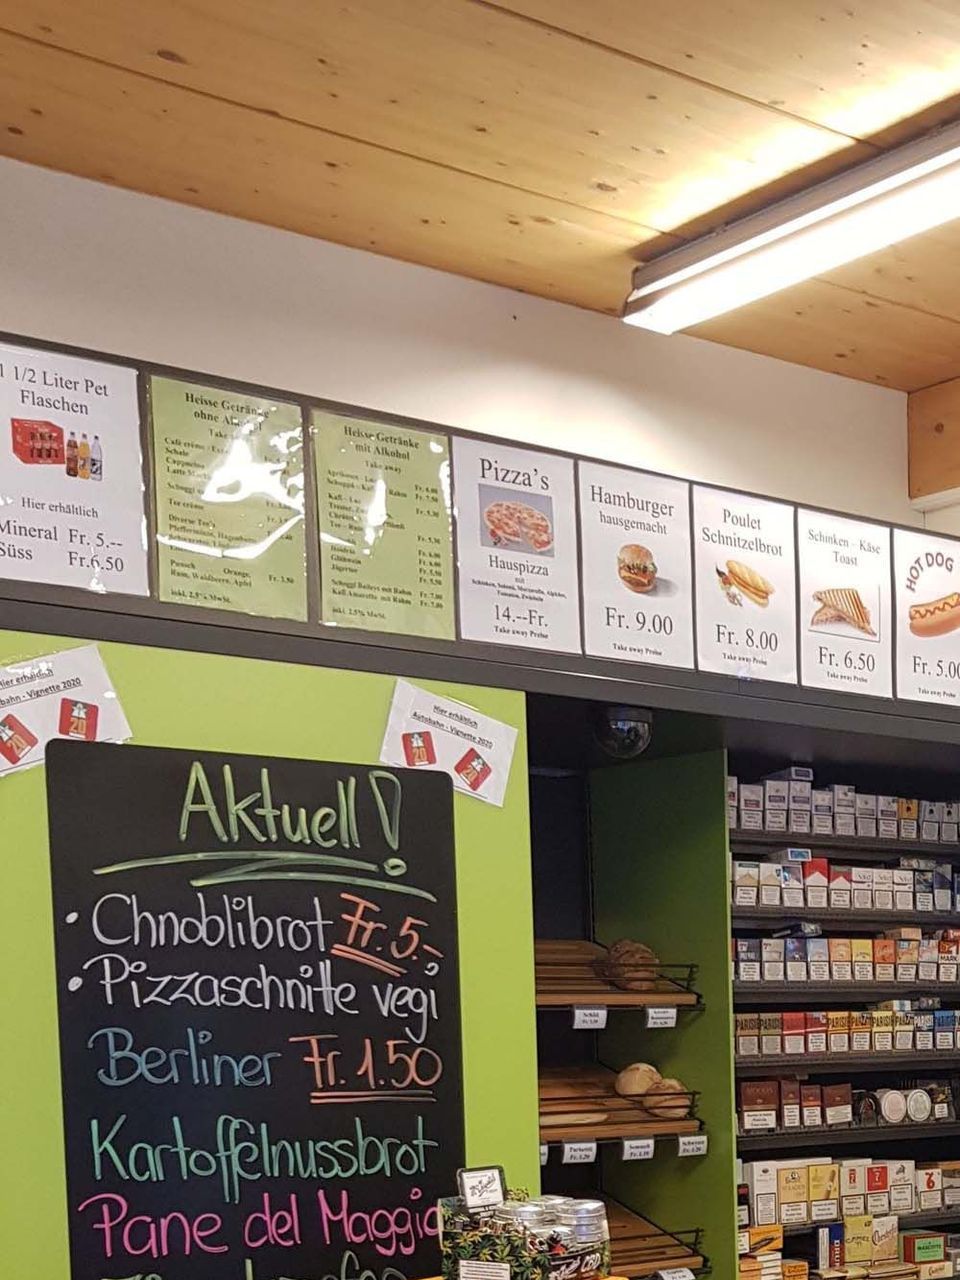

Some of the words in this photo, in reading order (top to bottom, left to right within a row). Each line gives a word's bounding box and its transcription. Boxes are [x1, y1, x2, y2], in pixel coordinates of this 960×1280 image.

[14, 366, 36, 383] 1/2
[43, 371, 79, 391] Liter
[85, 380, 109, 397] Pet
[20, 389, 88, 415] Flaschen
[185, 392, 218, 408] Heisse
[194, 410, 219, 422] ohne
[344, 425, 374, 439] Heisse
[376, 432, 420, 449] Getränke
[355, 443, 371, 453] mit
[374, 446, 410, 461] Alkohol
[479, 458, 549, 490] Pizza's
[22, 497, 45, 511] Hier
[49, 500, 98, 518] erhältlich
[591, 485, 674, 518] Hamburger
[600, 511, 667, 535] hausgemacht
[723, 509, 761, 530] Poulet
[69, 529, 90, 546] Fr.
[702, 528, 782, 556] Schnitzelbrot
[808, 529, 849, 548] Schinken
[859, 538, 880, 555] Käse
[489, 555, 549, 577] Hauspizza
[833, 551, 858, 566] Toast
[906, 557, 925, 592] HOT
[925, 552, 954, 573] DOG
[494, 625, 510, 635] Take
[605, 607, 629, 629] Fr.
[635, 611, 673, 635] 9.00
[716, 624, 739, 645] Fr.
[745, 629, 778, 651] 8.00
[818, 646, 839, 668] Fr.
[844, 651, 875, 671] 6.50
[913, 656, 931, 676] Fr.
[27, 684, 60, 698] Vignette
[62, 677, 82, 688] 2020
[433, 705, 447, 715] Hier
[69, 717, 87, 734] 20
[412, 711, 445, 729] Autobahn
[450, 726, 477, 743] Vignette
[413, 748, 428, 762] 20
[462, 765, 479, 780] 20
[340, 893, 386, 951] Fr.
[372, 962, 439, 1043] vegi
[88, 1027, 281, 1087] Berliner
[289, 1034, 345, 1088] Fr.
[357, 1038, 443, 1089] 1.50
[90, 1114, 438, 1203] Kartoffelnussbrot
[78, 1193, 228, 1259] Pane
[245, 1192, 301, 1248] del
[581, 1253, 601, 1273] CBD
